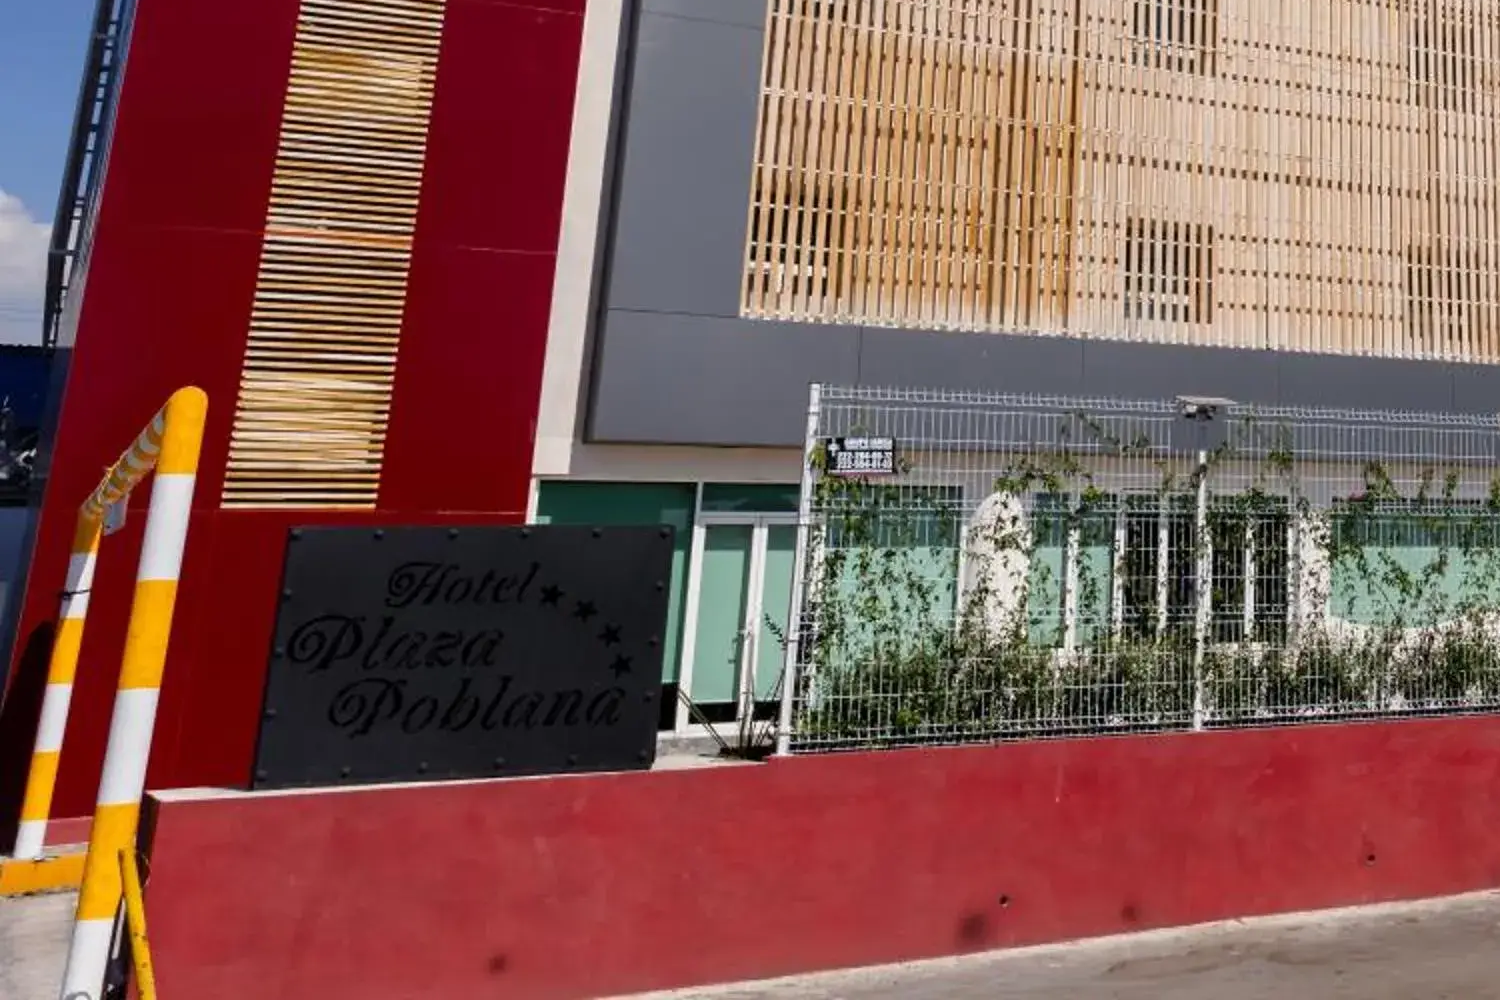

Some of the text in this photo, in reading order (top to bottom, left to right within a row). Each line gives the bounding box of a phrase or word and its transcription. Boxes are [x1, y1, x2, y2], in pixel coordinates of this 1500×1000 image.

[385, 560, 541, 607] Hotel
[286, 614, 505, 674] Plaza
[327, 676, 629, 739] Poblana
